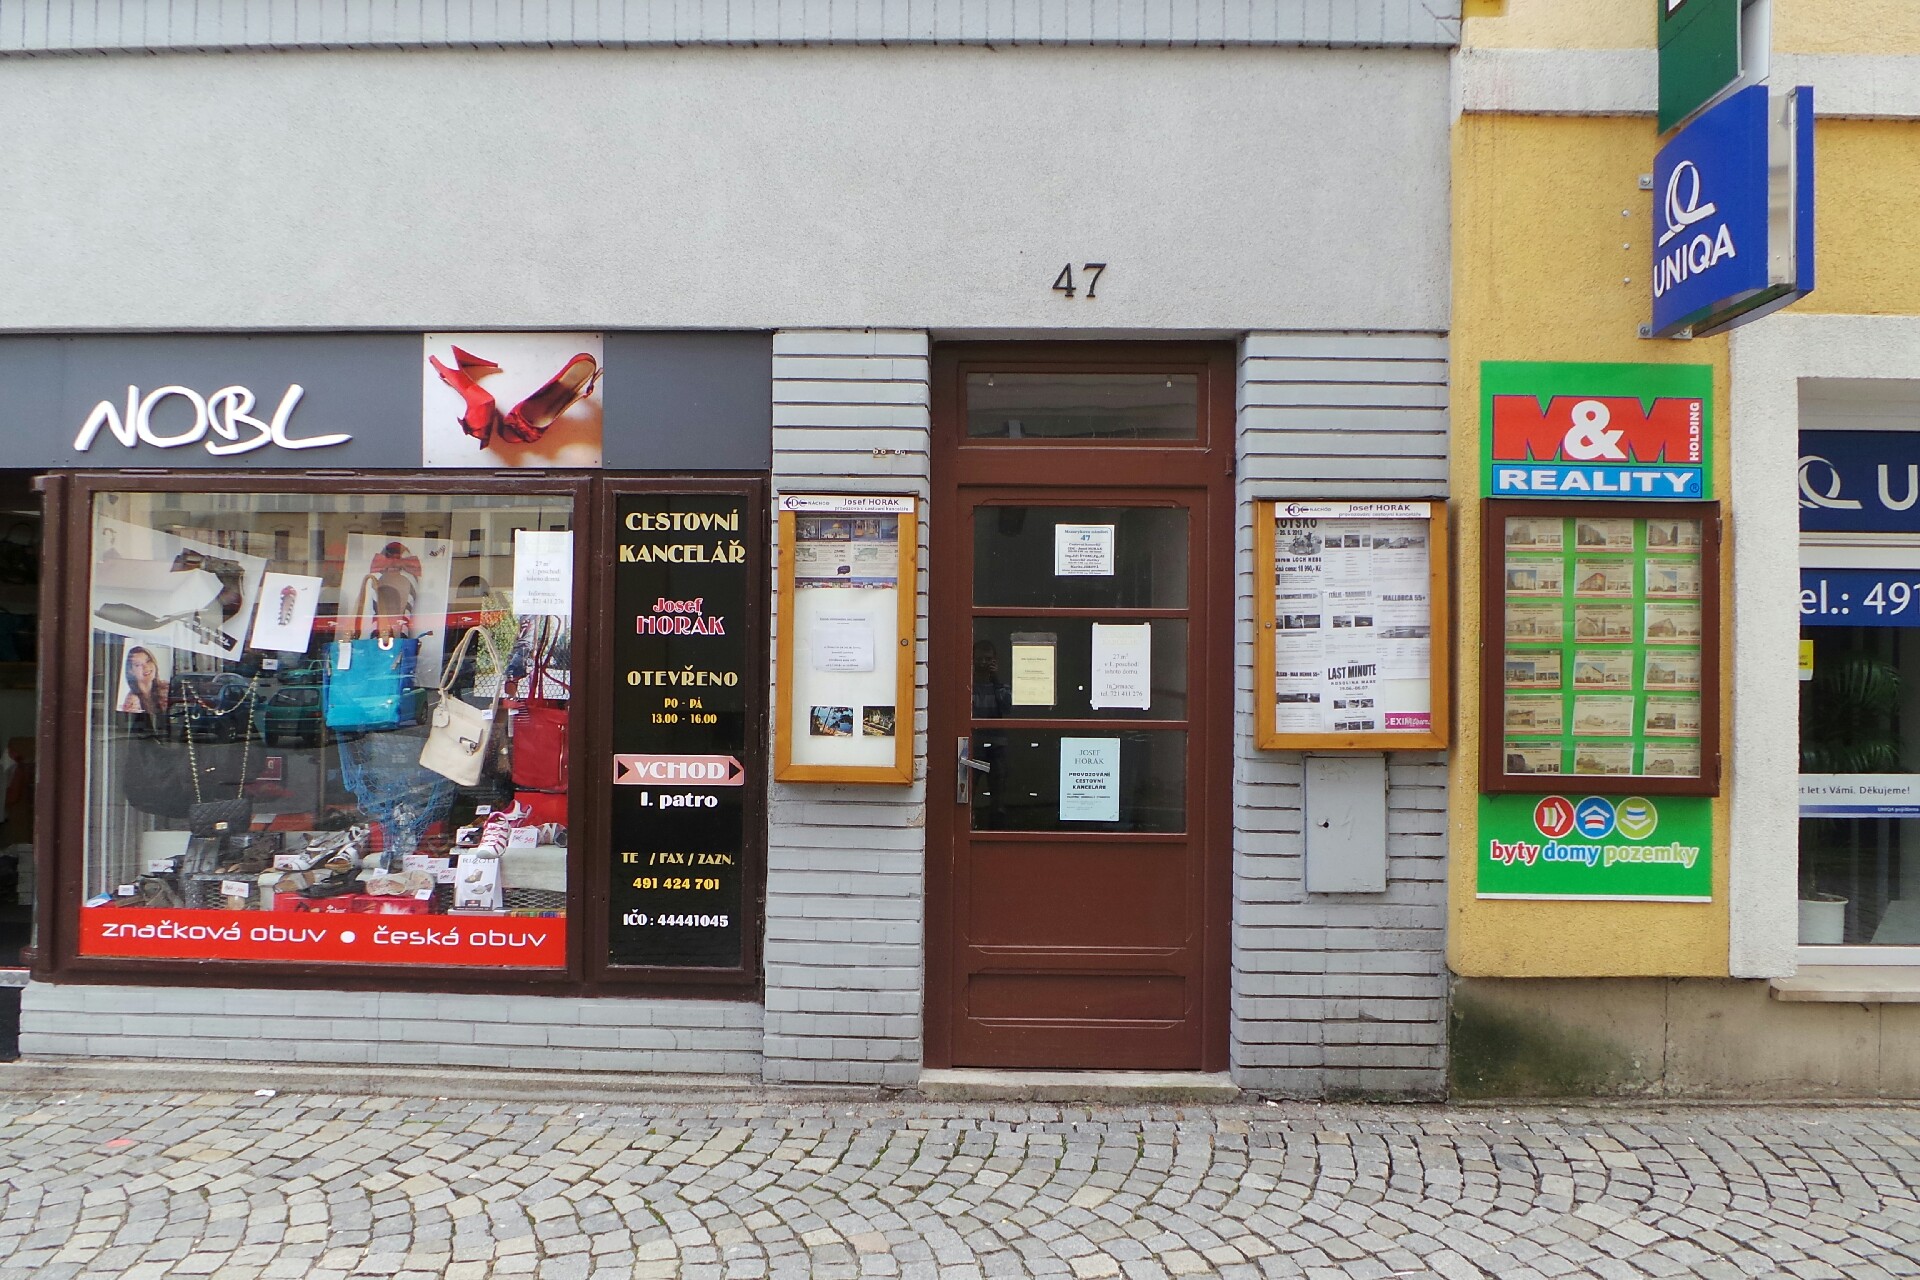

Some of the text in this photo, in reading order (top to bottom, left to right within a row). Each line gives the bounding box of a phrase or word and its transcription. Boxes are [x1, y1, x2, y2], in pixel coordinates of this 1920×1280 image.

[1653, 223, 1736, 298] UNIQA
[1052, 263, 1106, 298] 47
[73, 383, 353, 456] NOBL
[1492, 395, 1703, 463] M&M
[1689, 402, 1700, 461] HOLDING
[1499, 469, 1694, 493] REALITY
[1878, 464, 1918, 510] U
[844, 498, 866, 506] Josef
[868, 498, 899, 506] HORÁK
[1349, 504, 1373, 512] Josef
[1376, 503, 1411, 511] HORÁK
[625, 509, 739, 531] CESTOVNÍ
[619, 540, 746, 563] KANCELÁŘ
[653, 598, 703, 613] Josef
[636, 612, 725, 635] HORÁK
[627, 665, 738, 687] OTEVŘENO
[1328, 664, 1377, 680] LAST MINUTE
[664, 698, 678, 708] PO
[689, 697, 703, 709] PÁ
[651, 713, 678, 724] 13.00
[690, 713, 718, 724] 16.00
[1389, 717, 1413, 726] EXIM
[634, 761, 726, 779] VCHOD
[659, 792, 718, 809] patro
[1808, 786, 1819, 794] let
[1859, 786, 1910, 796] Děkujeme!
[659, 852, 684, 864] FAX
[697, 853, 735, 866] ZAZN.
[1490, 840, 1699, 869] byty domy pozemky
[632, 877, 720, 890] 491 424 701
[101, 919, 326, 942] značková obuv
[657, 914, 729, 927] 44441045
[373, 925, 547, 947] česká obuv
